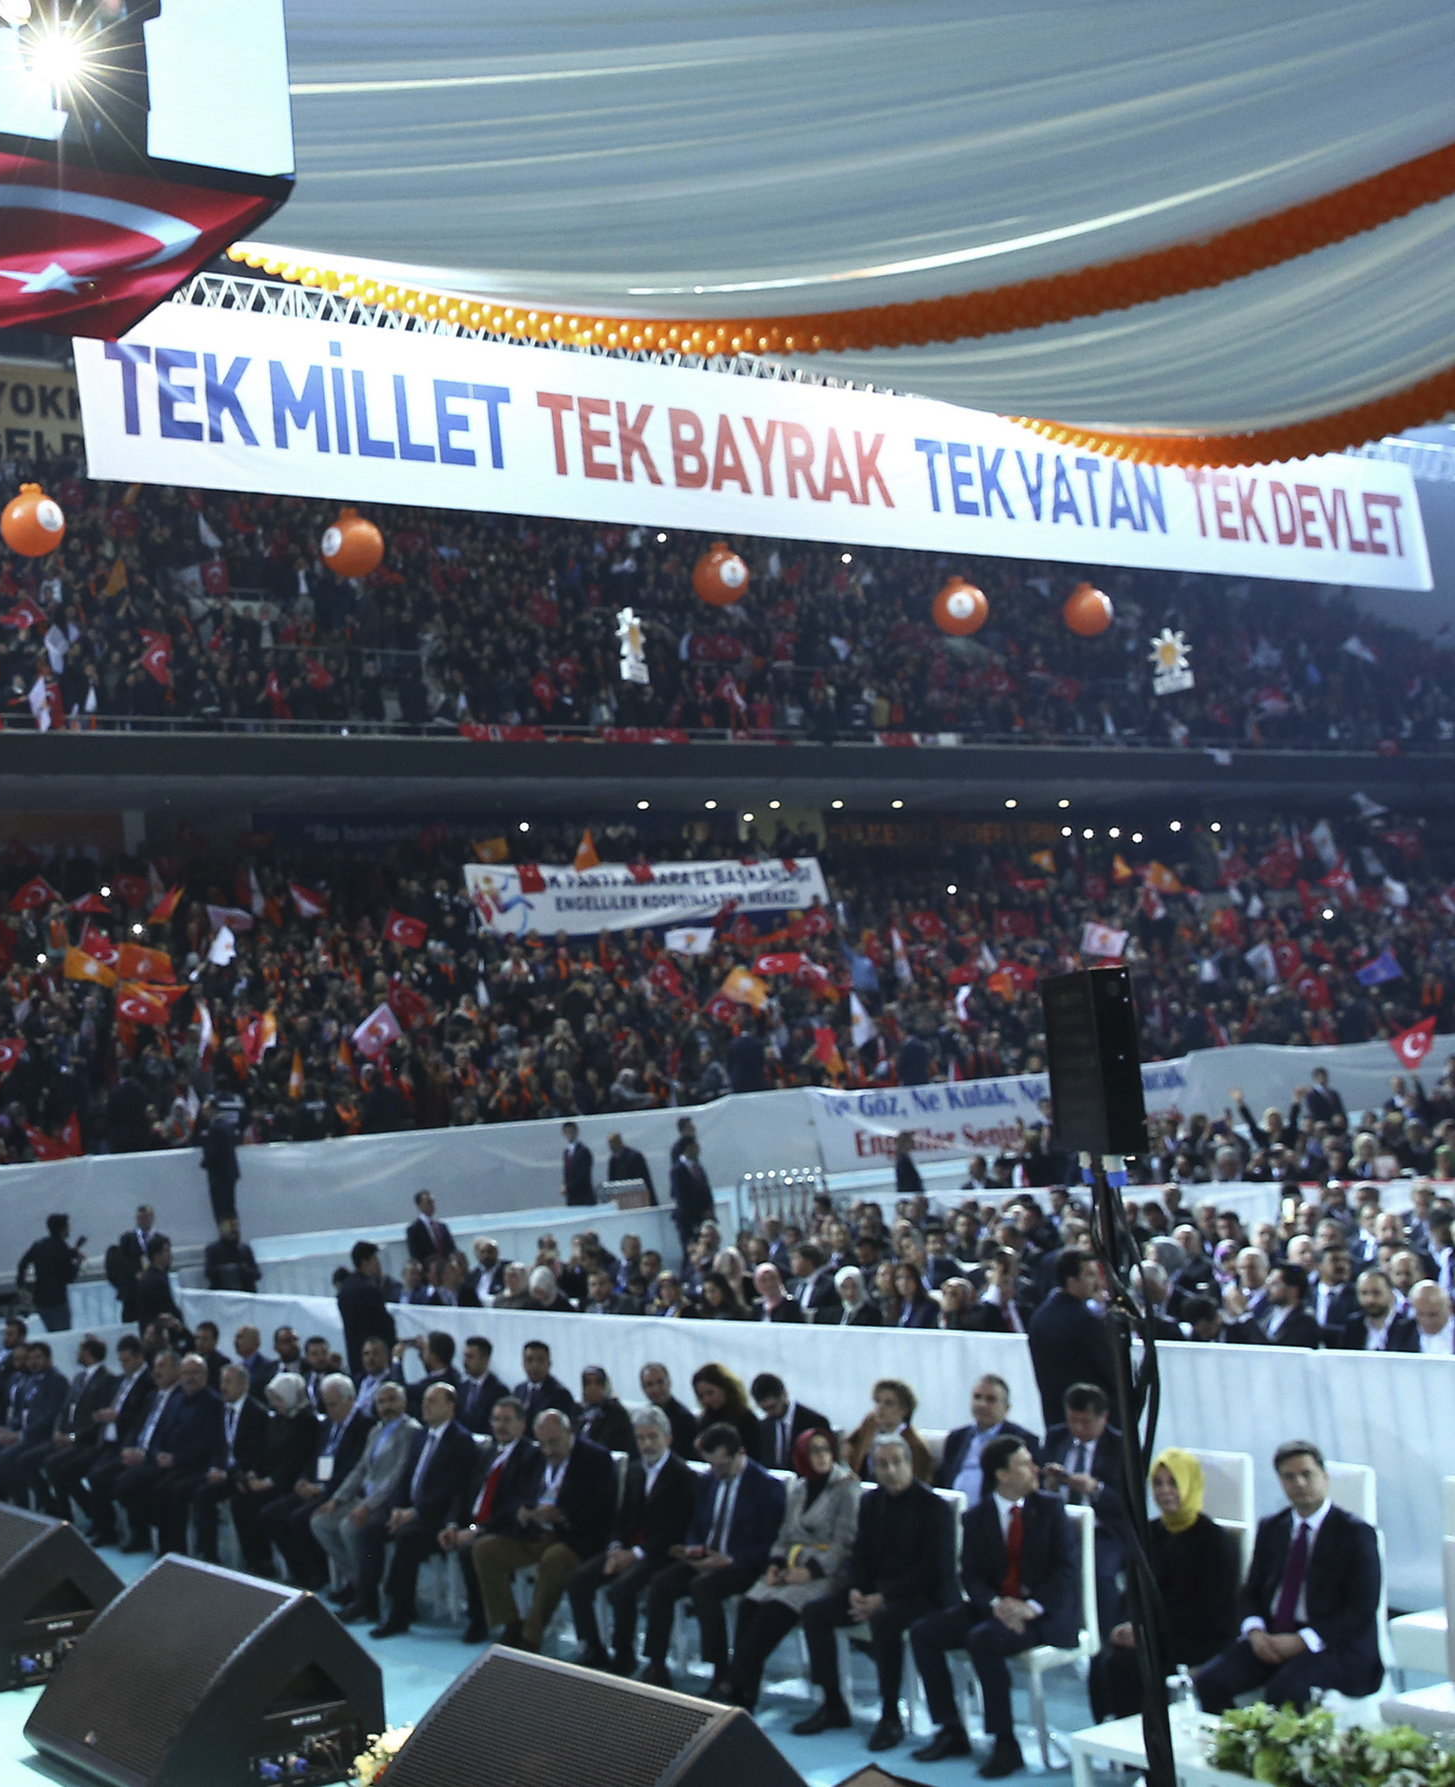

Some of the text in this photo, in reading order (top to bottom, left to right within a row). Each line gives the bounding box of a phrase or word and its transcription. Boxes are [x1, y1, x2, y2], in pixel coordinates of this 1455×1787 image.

[105, 341, 1404, 557] TEK MİLLET TEK BAYRAK TEK VATAN TEK DEVLET
